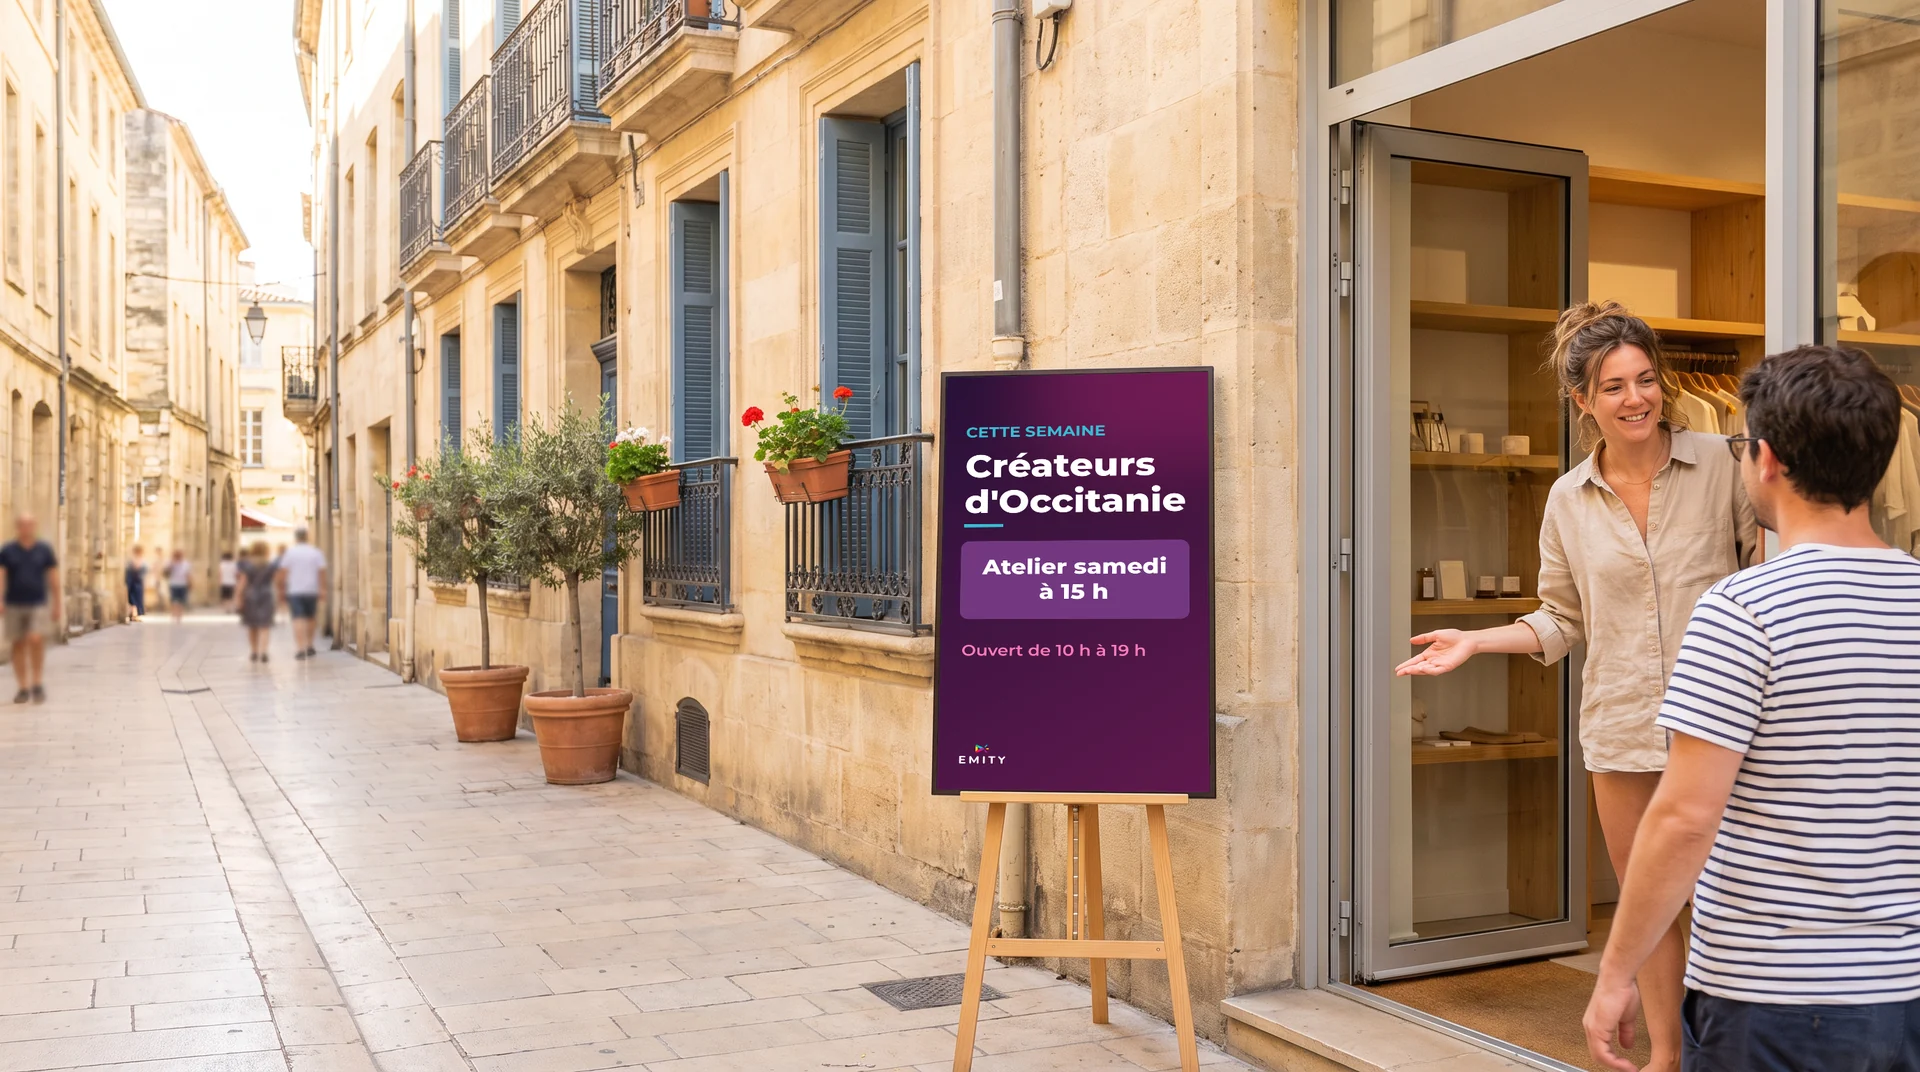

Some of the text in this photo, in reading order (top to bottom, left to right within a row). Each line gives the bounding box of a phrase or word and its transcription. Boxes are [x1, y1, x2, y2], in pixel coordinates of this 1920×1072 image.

[966, 424, 1106, 439] CETTE SEMAINE
[966, 452, 1156, 479] Créateurs
[965, 485, 1186, 514] d'Occitanie
[981, 556, 1167, 575] Atelier samedi
[1039, 582, 1108, 600] à 15 h
[961, 643, 1146, 657] Ouvert de 10 h à 19 h
[958, 755, 1006, 765] EMITY
